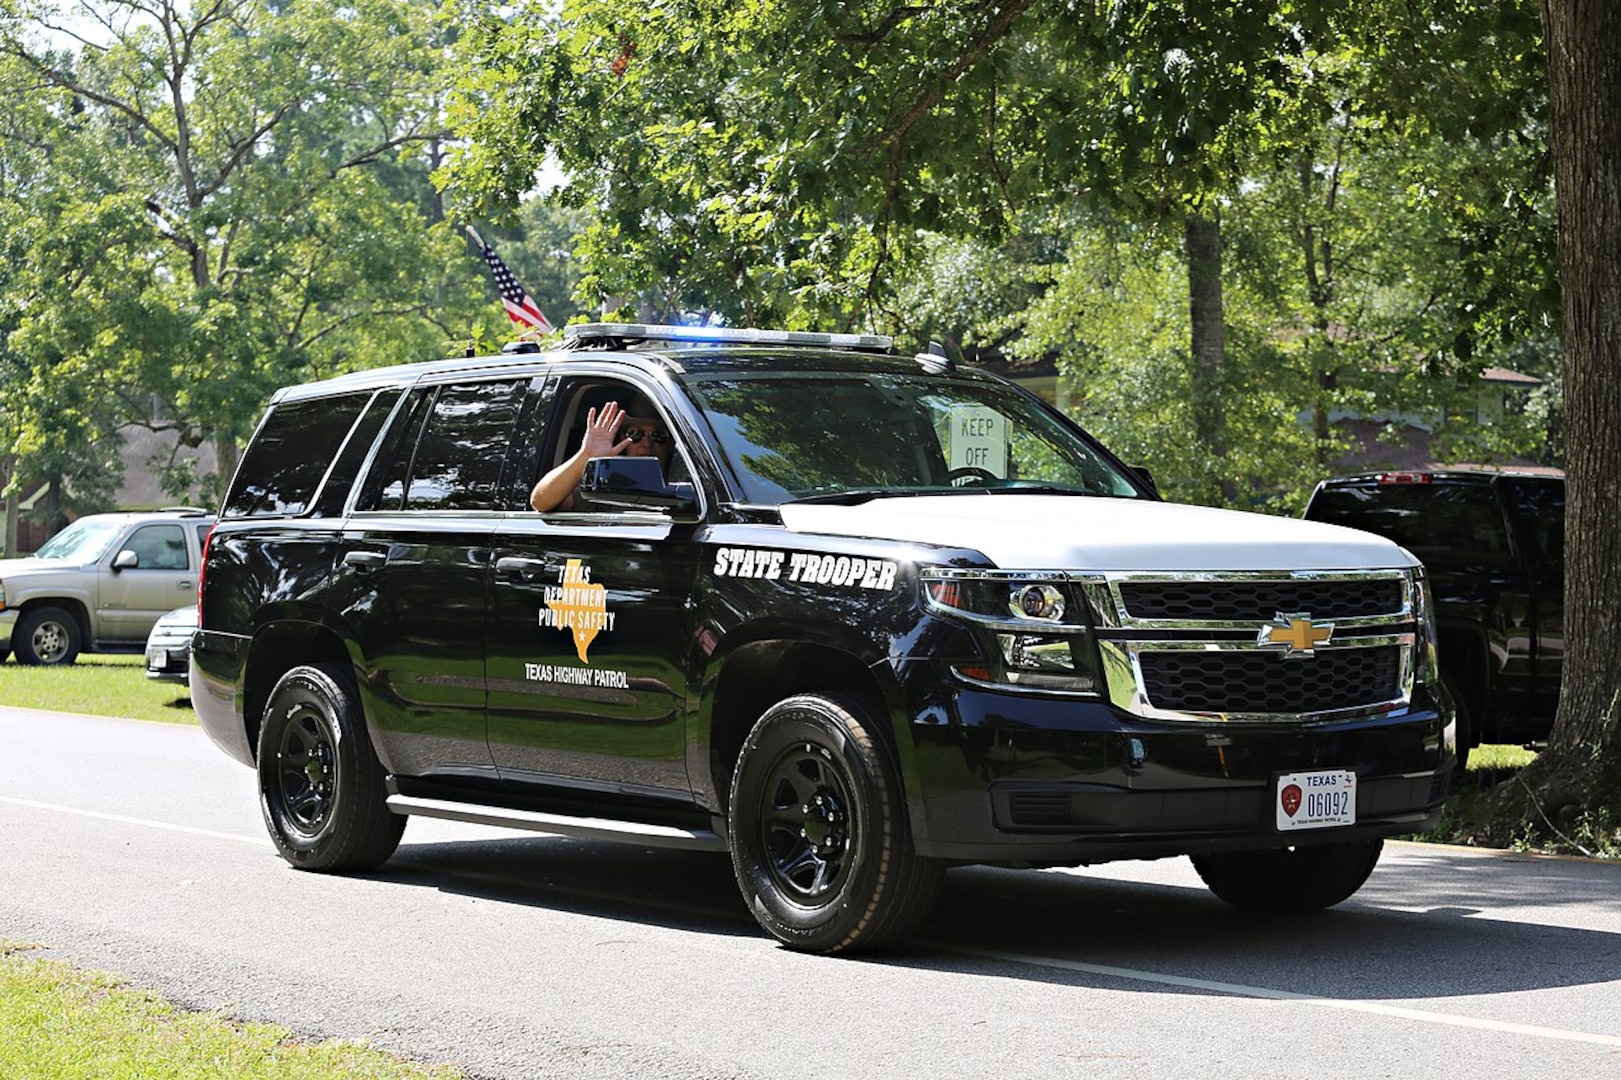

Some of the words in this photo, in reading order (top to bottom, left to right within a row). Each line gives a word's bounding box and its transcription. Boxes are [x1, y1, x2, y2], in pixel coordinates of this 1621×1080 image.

[961, 418, 994, 437] KEEP
[965, 447, 989, 466] OFF
[557, 565, 591, 584] TEXAS
[713, 547, 785, 580] STATE
[788, 552, 898, 591] TROOPER
[543, 586, 609, 608] DEPARTMENT
[538, 607, 575, 629] PUBLIC
[577, 610, 616, 632] SAFETY
[524, 662, 553, 682] TEXAS
[553, 665, 594, 686] HIGHWAY
[594, 669, 630, 689] PATROL
[1306, 774, 1337, 787] TEXAS
[1308, 791, 1348, 817] 06092
